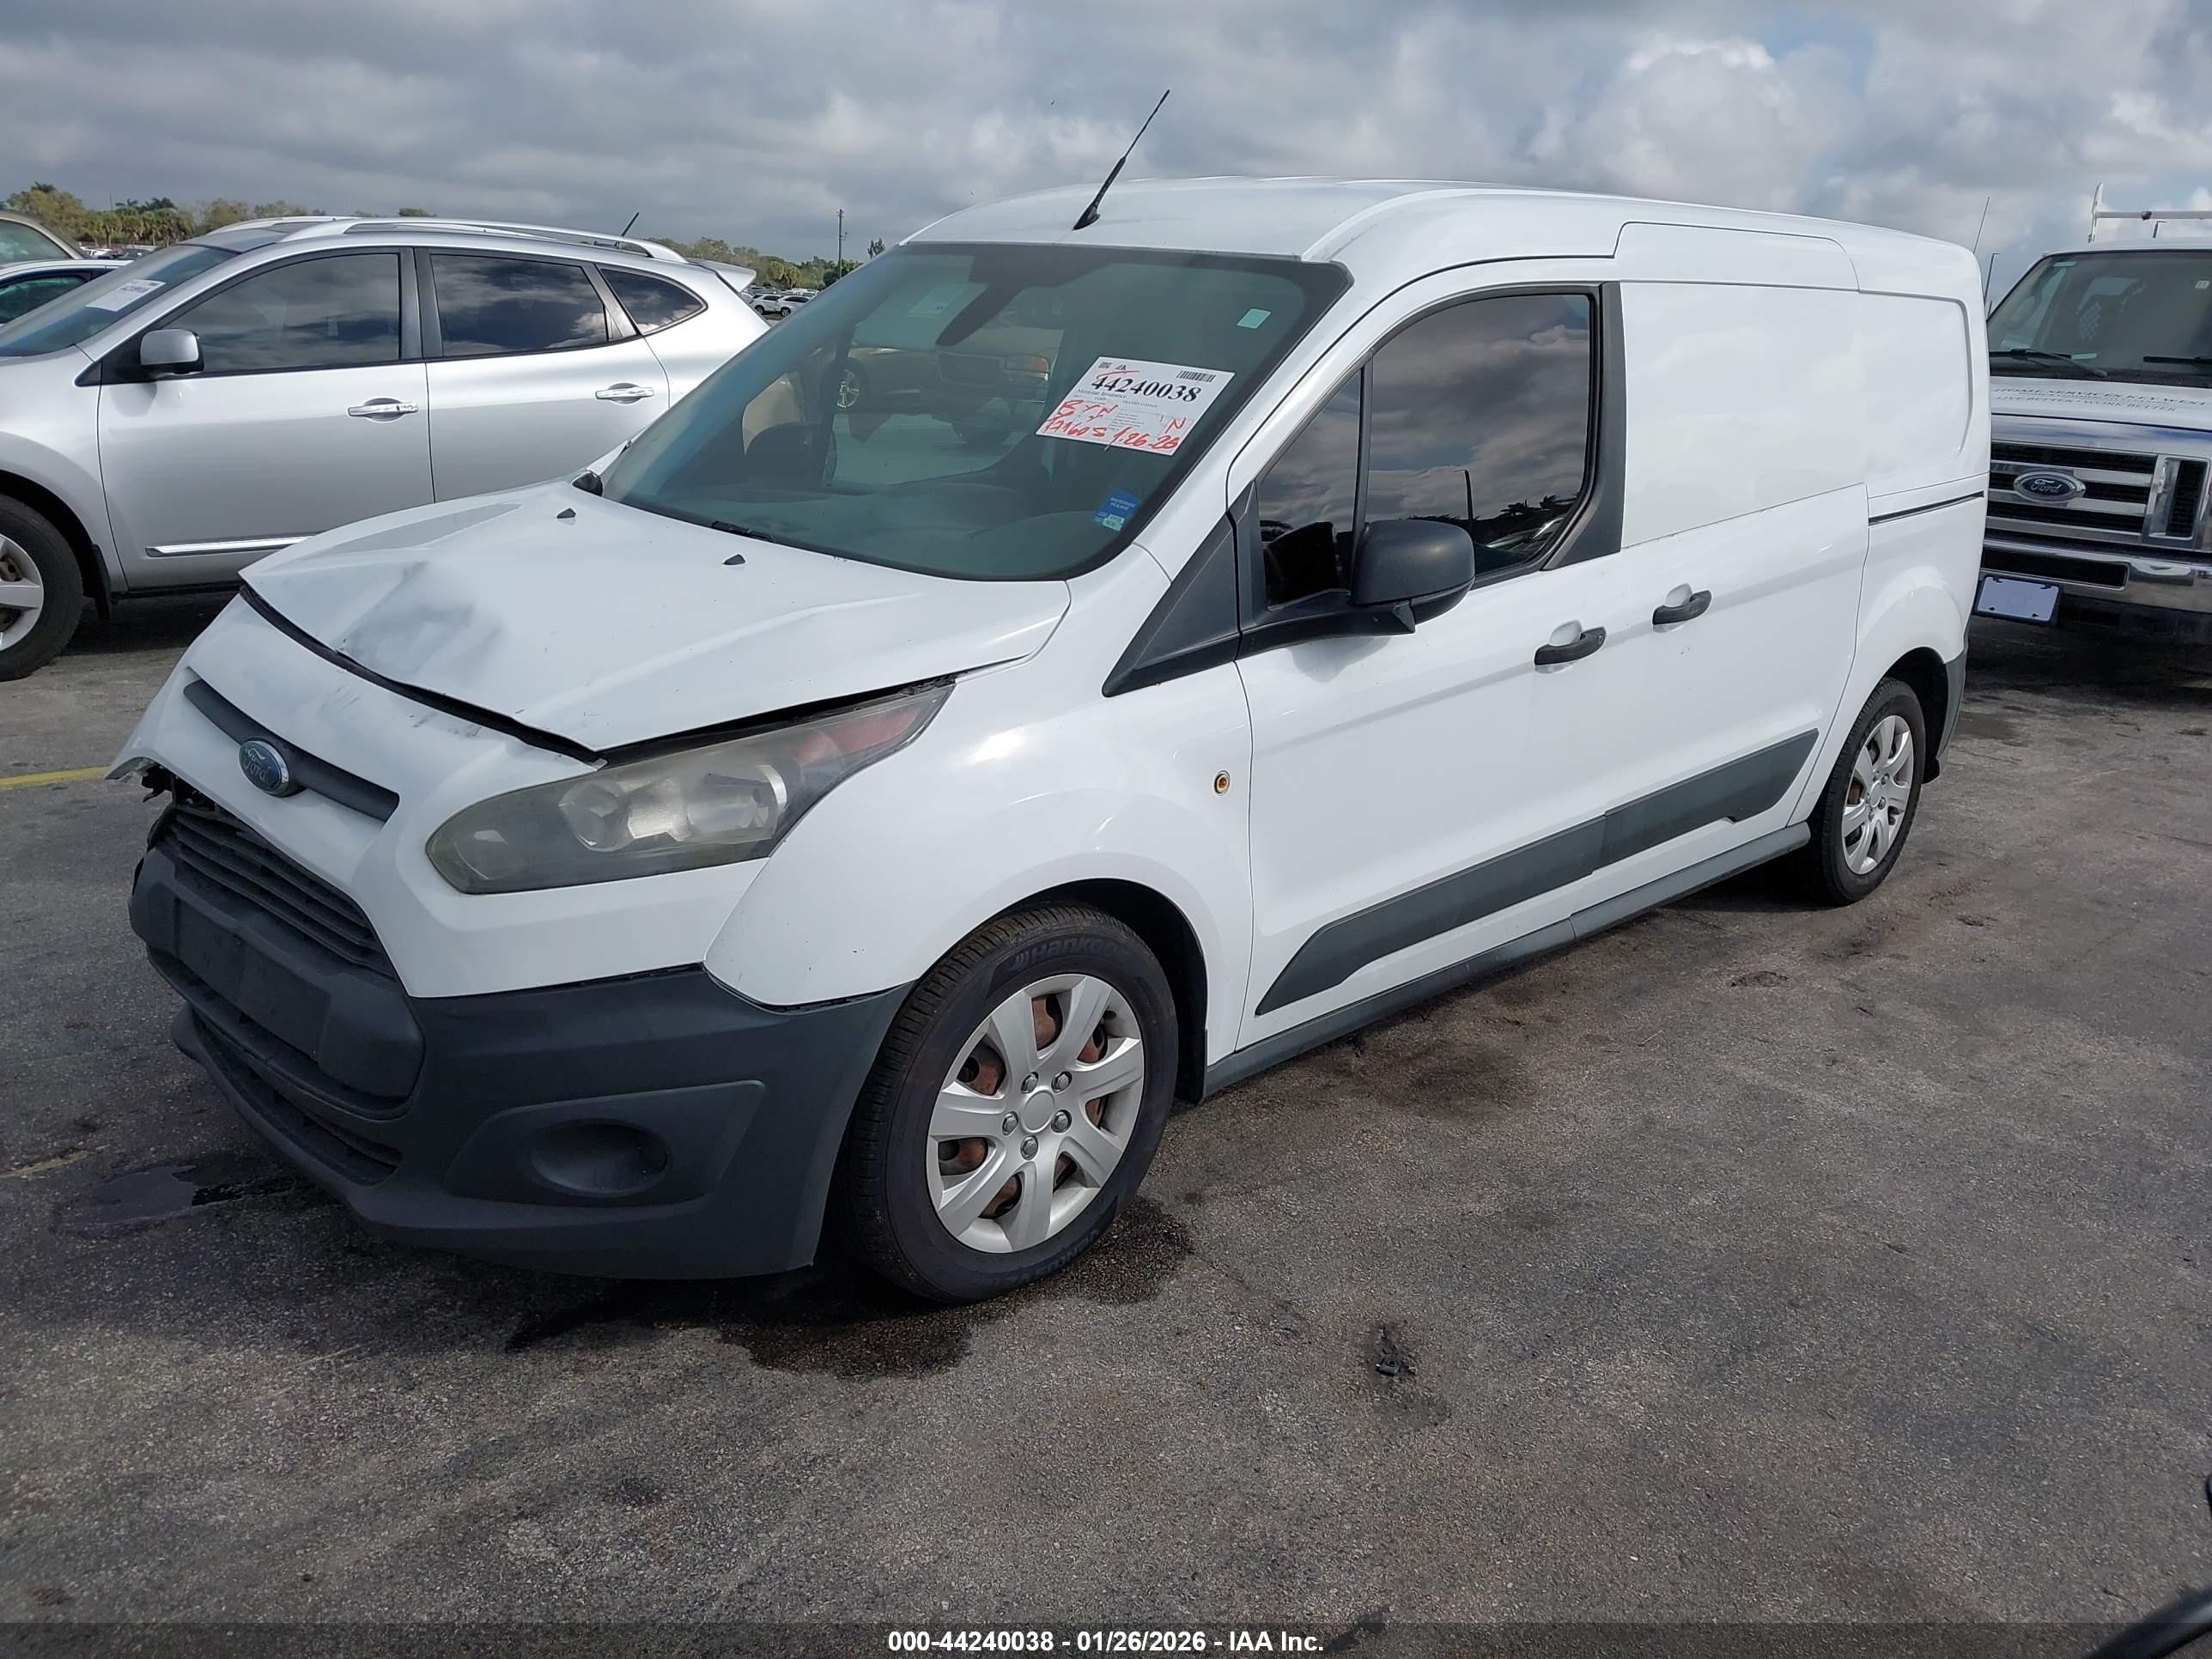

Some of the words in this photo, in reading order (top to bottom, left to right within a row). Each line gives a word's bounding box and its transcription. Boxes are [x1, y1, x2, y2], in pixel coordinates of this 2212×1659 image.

[1091, 376, 1202, 403] 44240038
[2030, 478, 2063, 493] Ford
[243, 748, 271, 782] Ford
